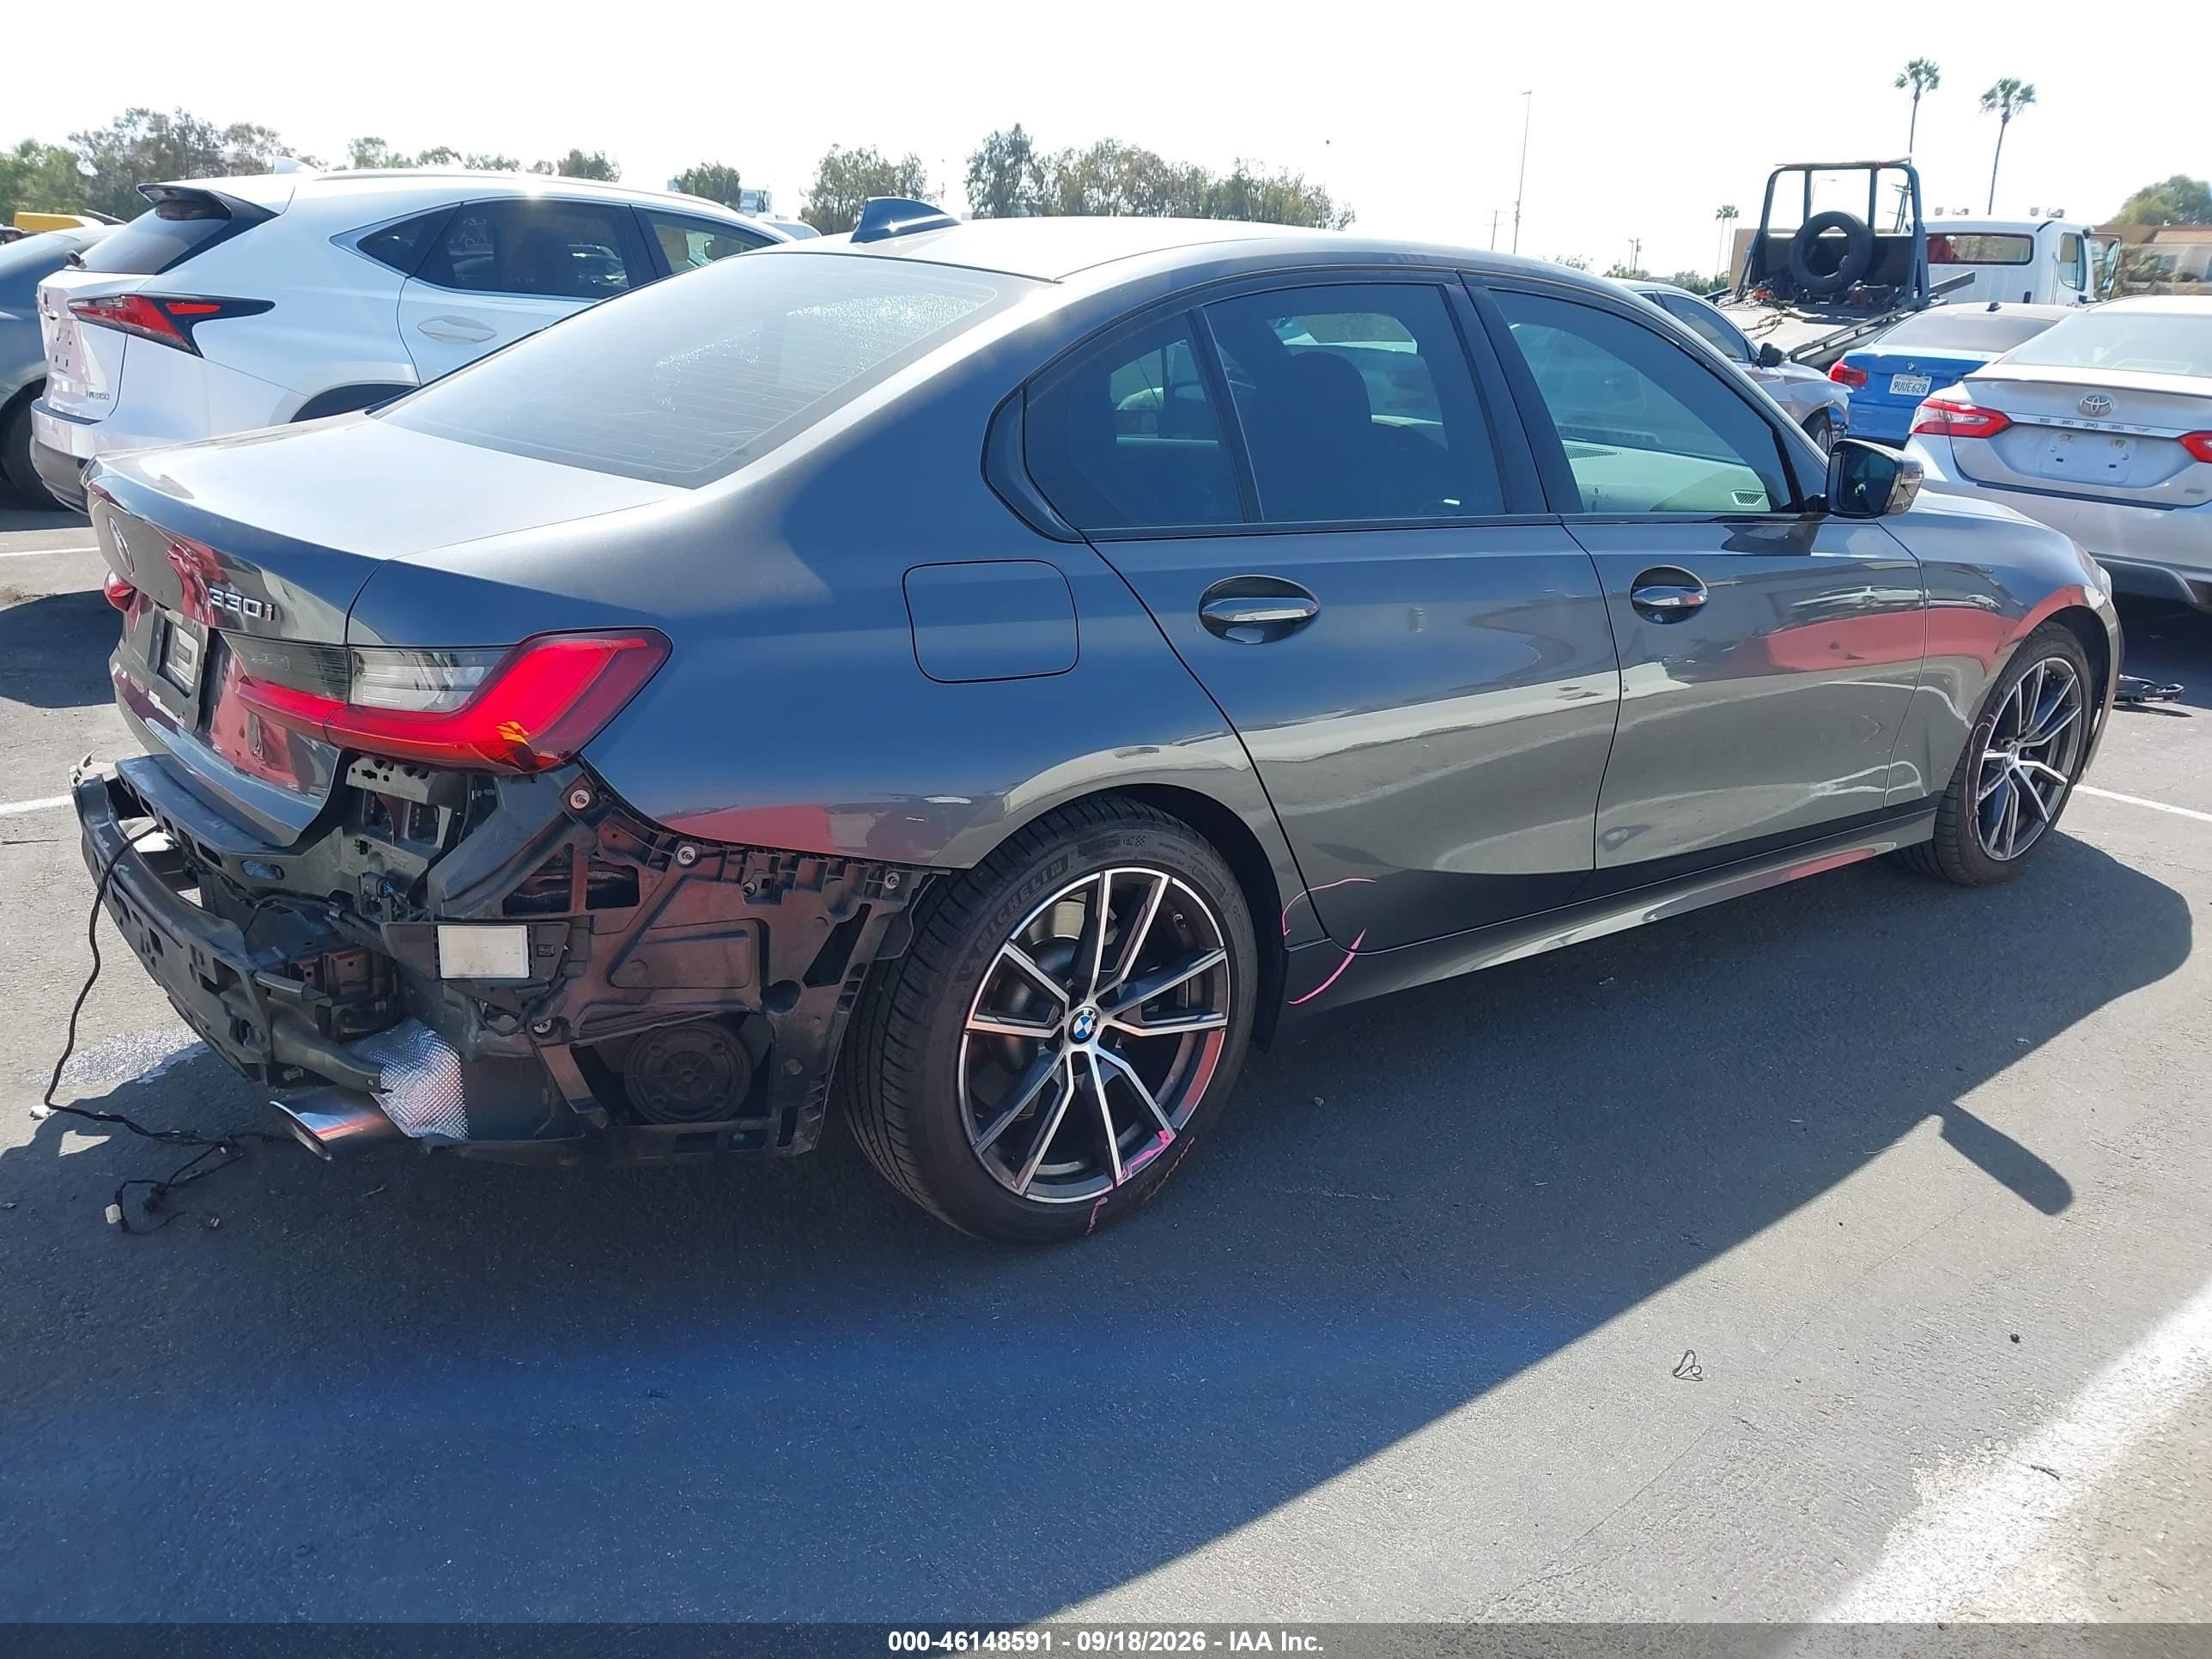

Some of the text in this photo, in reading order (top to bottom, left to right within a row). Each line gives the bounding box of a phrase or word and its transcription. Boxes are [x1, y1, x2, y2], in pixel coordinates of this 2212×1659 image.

[1893, 381, 1928, 393] 9UUE628
[208, 587, 276, 622] 330i
[975, 859, 1064, 952] MICHELIN
